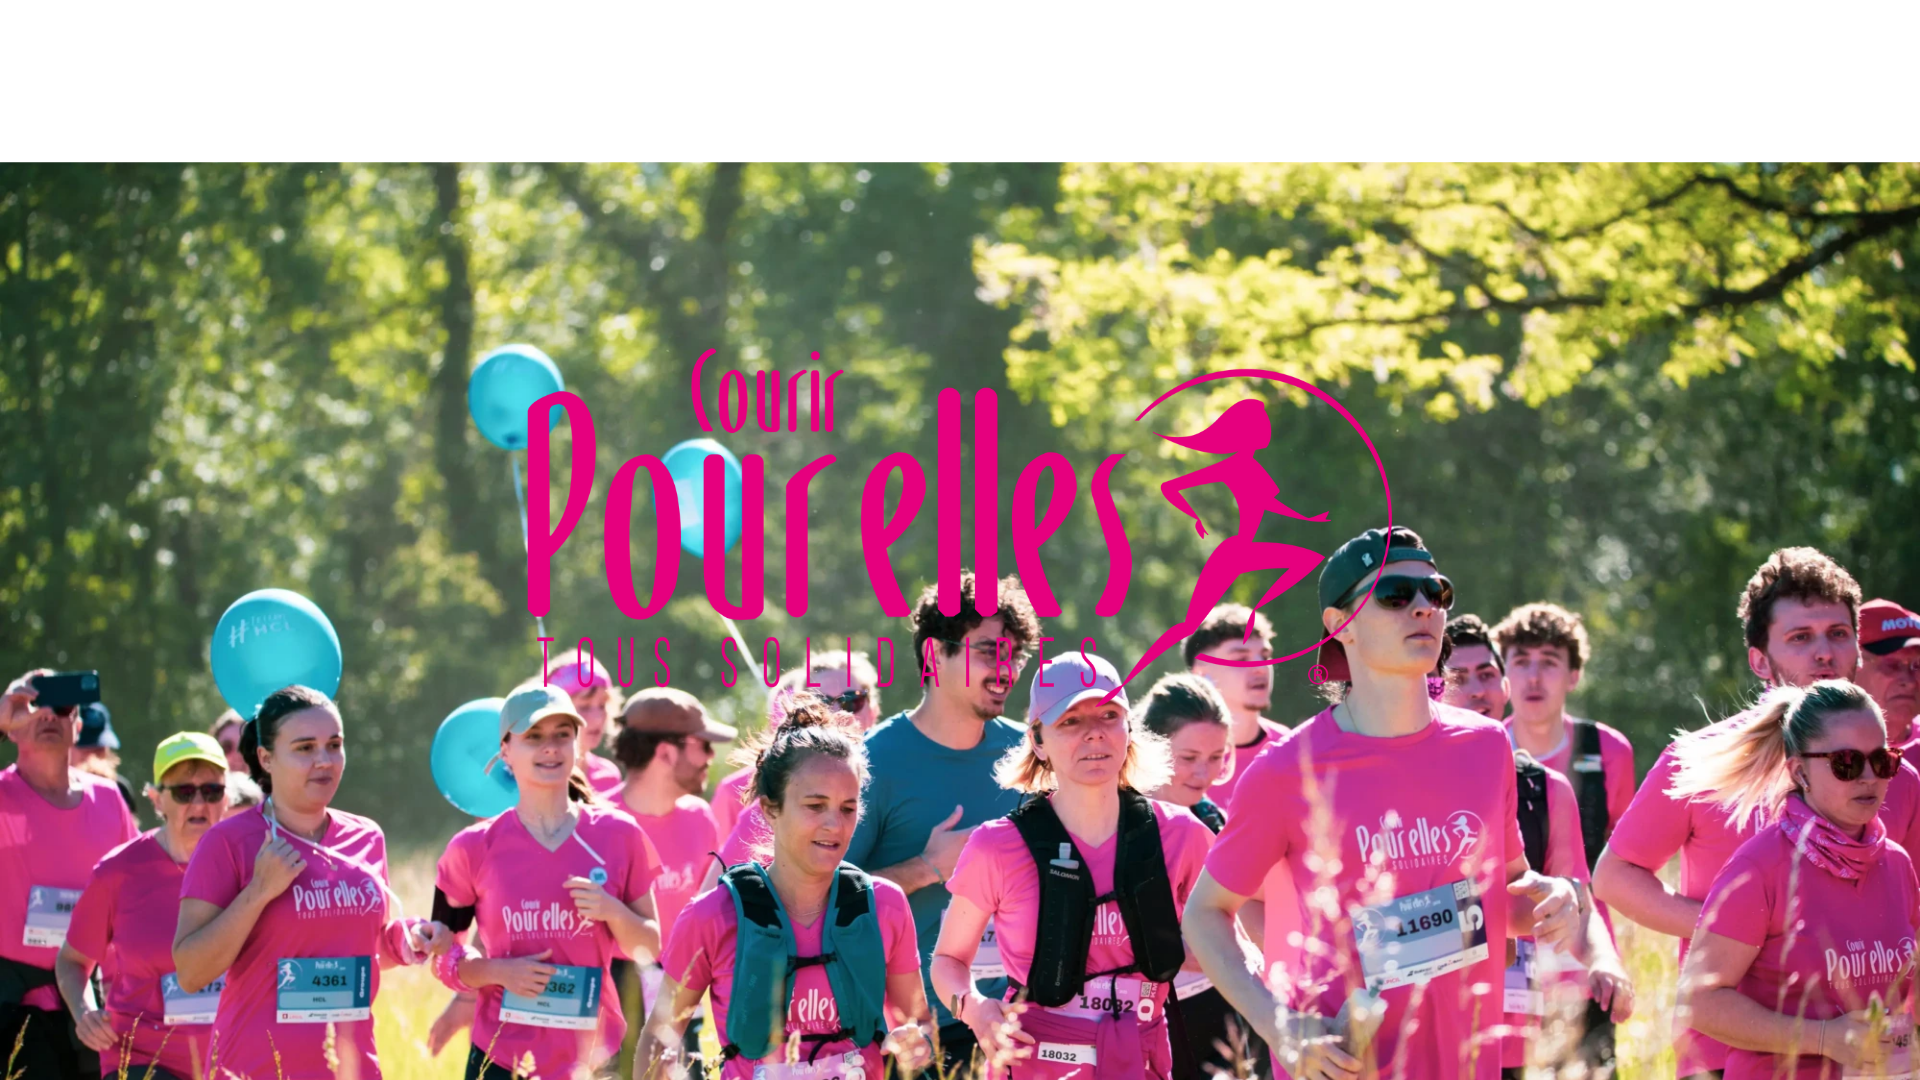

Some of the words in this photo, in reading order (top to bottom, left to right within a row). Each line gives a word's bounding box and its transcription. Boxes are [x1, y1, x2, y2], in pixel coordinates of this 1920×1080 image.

[1408, 817, 1451, 857] elles
[1049, 868, 1081, 881] SALOMON
[1392, 854, 1449, 871] SOLIDAIRES
[293, 884, 331, 912] Pour
[334, 880, 366, 908] elles
[502, 905, 541, 934] Pour
[542, 902, 575, 931] elles
[1092, 902, 1124, 936] lles
[1396, 908, 1454, 938] 11690
[1825, 948, 1867, 982] Pour
[1869, 940, 1903, 974] elles
[312, 974, 348, 987] 4361
[544, 981, 576, 995] 362
[1829, 980, 1850, 990] TOUS
[1853, 974, 1899, 988] SOLIDAIRES
[798, 988, 836, 1023] elles
[1041, 1049, 1077, 1062] 18032
